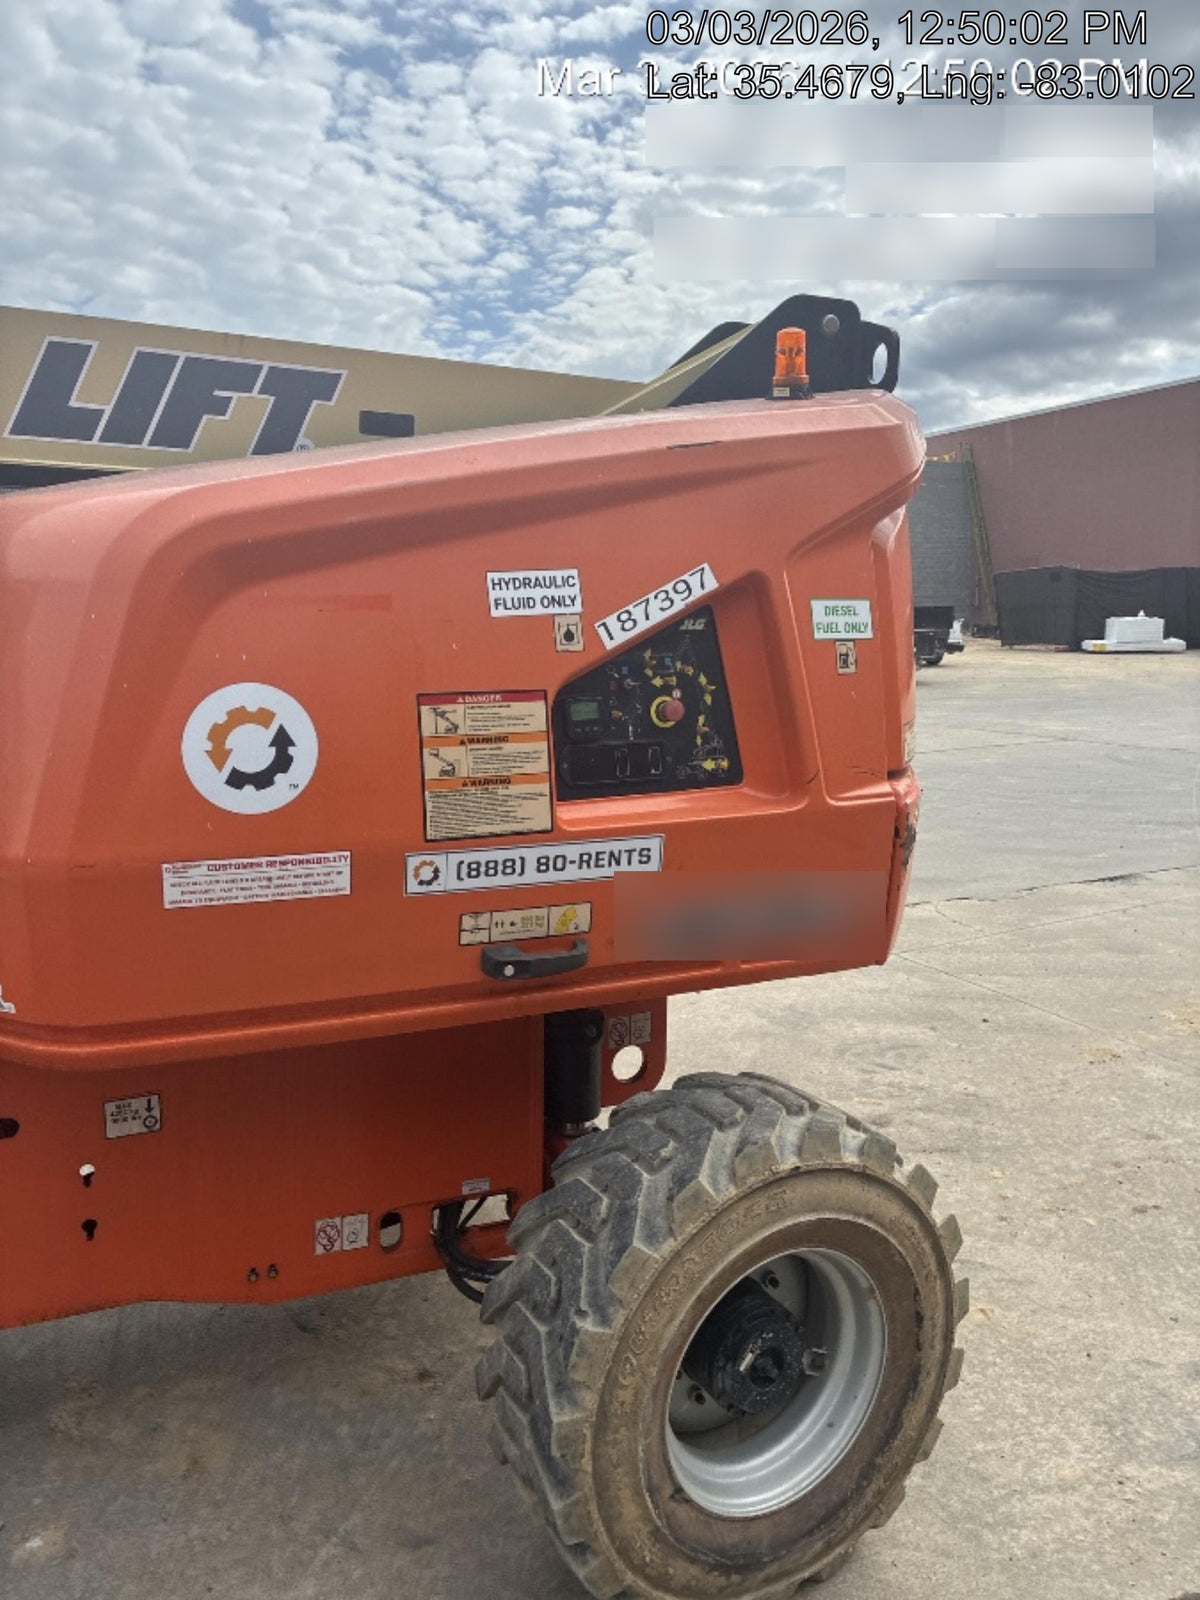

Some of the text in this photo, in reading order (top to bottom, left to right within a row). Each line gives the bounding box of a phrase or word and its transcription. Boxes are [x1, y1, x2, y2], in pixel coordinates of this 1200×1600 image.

[3, 335, 348, 457] LIFT
[491, 575, 577, 591] HYDRAULIC
[493, 595, 577, 611] FLUID ONLY
[596, 566, 709, 642] 187397
[824, 605, 860, 617] DIESEL
[815, 622, 869, 634] FUEL ONLY
[456, 847, 653, 881] (888) 80-RENTS
